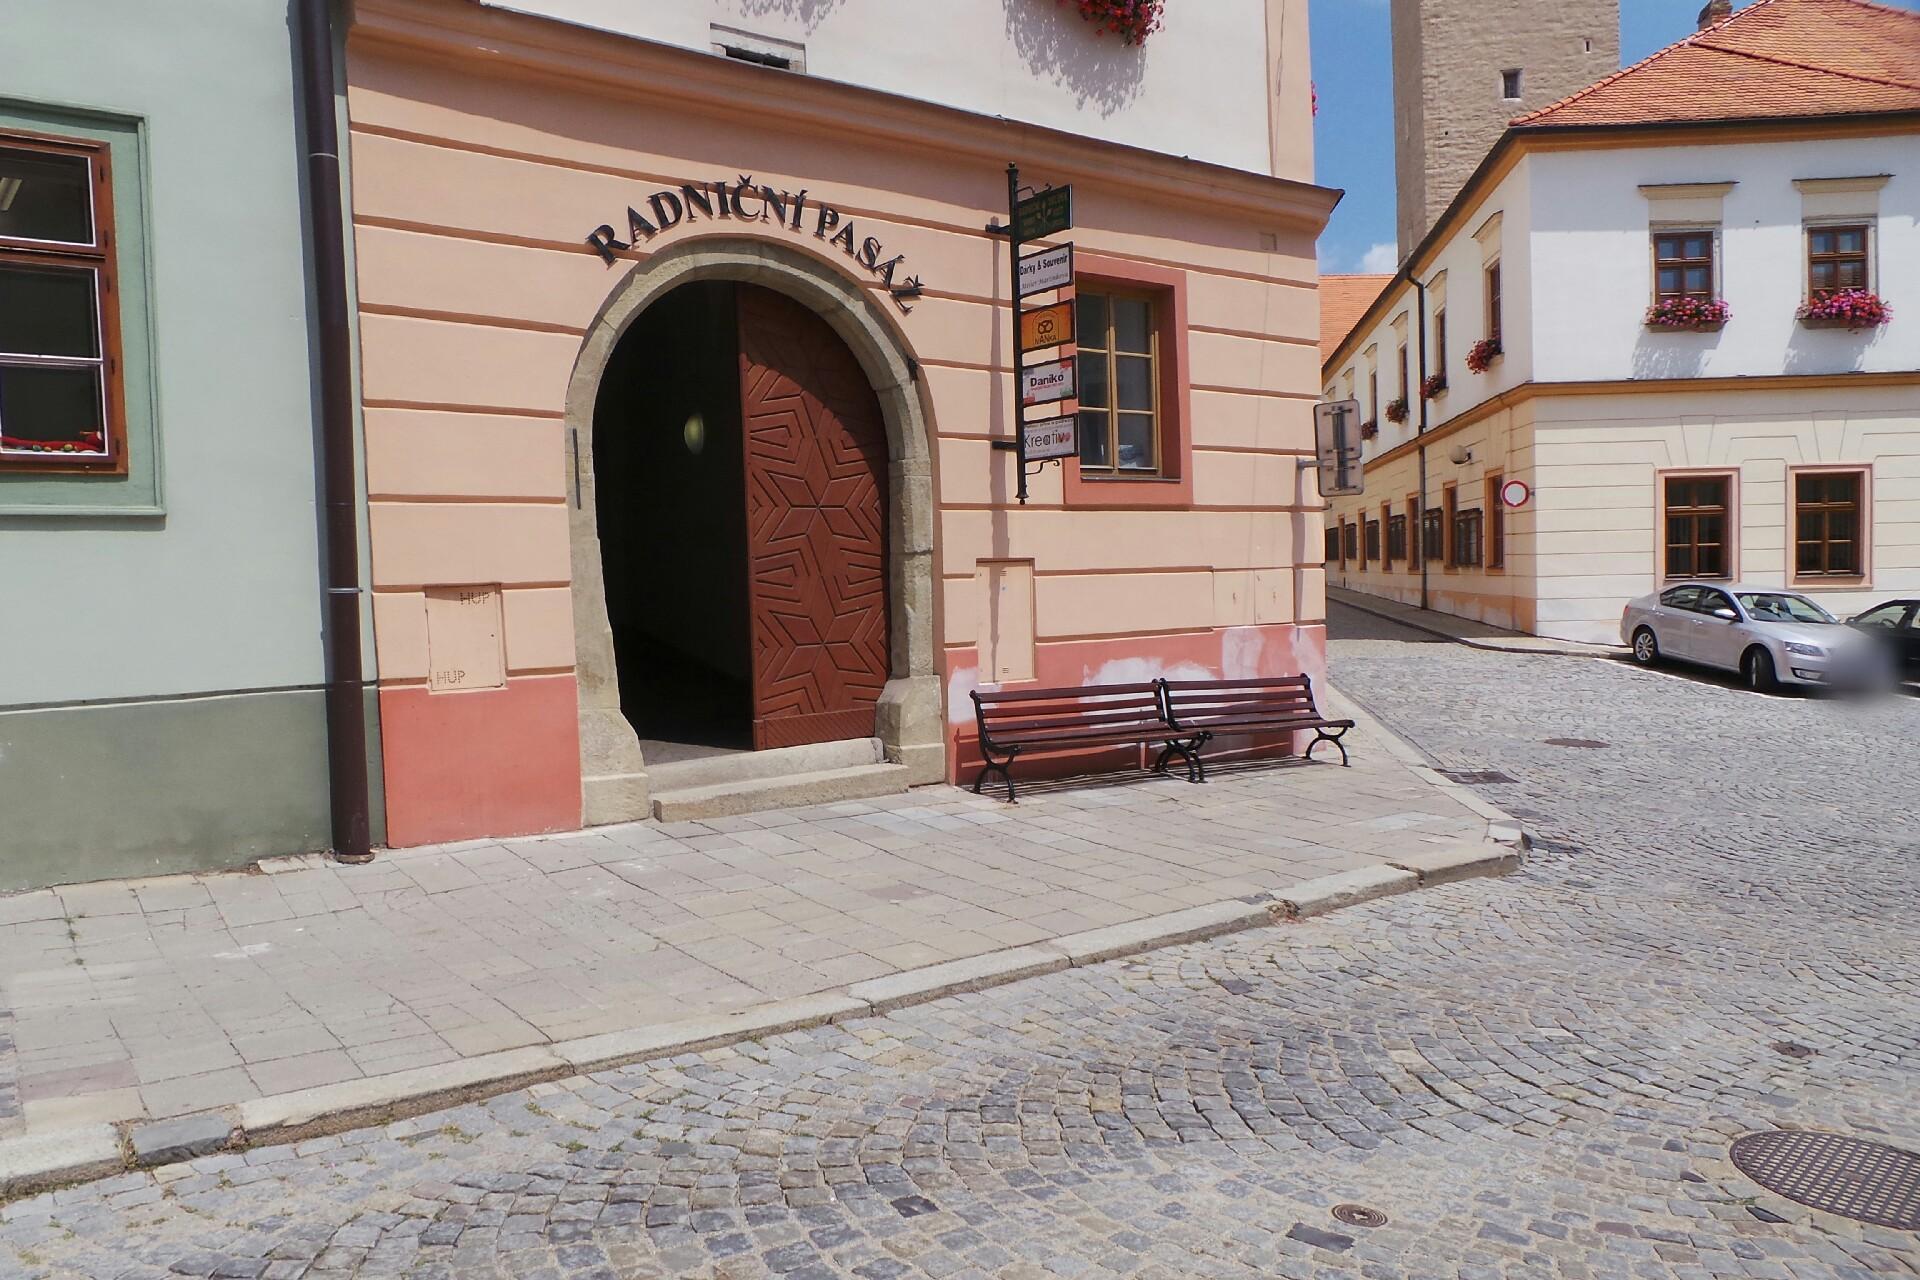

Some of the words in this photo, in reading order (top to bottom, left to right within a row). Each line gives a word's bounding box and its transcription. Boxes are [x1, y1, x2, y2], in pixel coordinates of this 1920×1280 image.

[585, 174, 808, 269] RADNIČNÍ
[813, 203, 925, 314] PASÁŽ
[1030, 374, 1064, 387] Daniko
[460, 592, 490, 605] HUP
[436, 670, 466, 684] HUP
